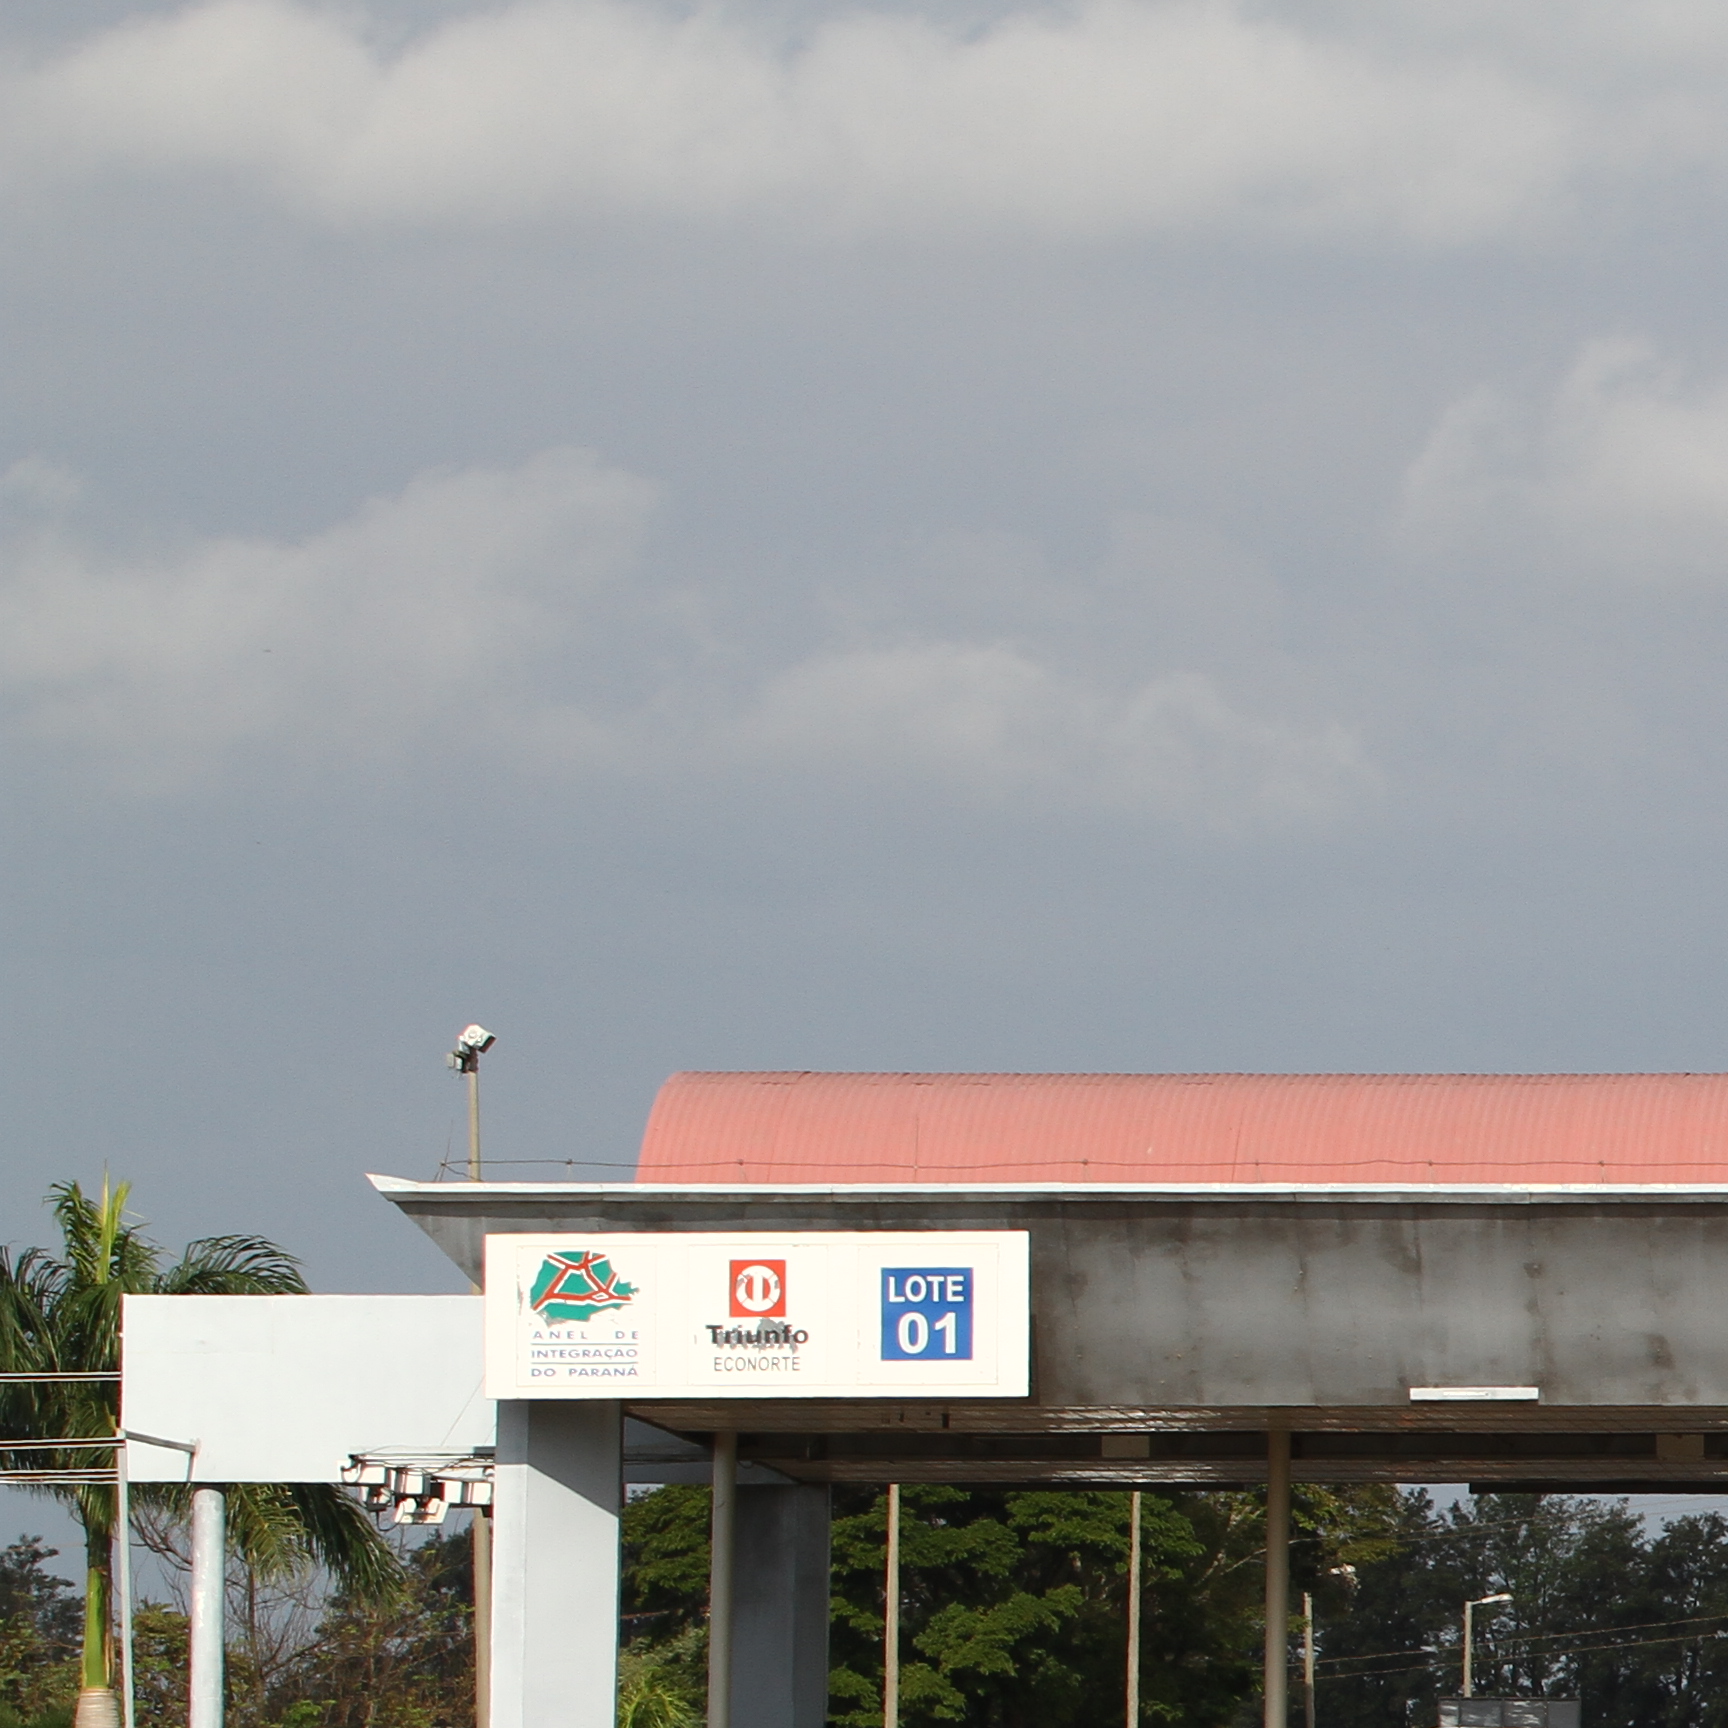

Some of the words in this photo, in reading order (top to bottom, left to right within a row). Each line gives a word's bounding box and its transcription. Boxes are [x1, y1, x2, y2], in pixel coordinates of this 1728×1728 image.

[887, 1274, 965, 1303] LOTE
[532, 1330, 588, 1340] ANEL
[614, 1330, 639, 1340] DE
[705, 1323, 809, 1345] Triunfo
[897, 1311, 957, 1355] 01
[531, 1346, 638, 1360] INTEGRAÇÃO
[531, 1368, 556, 1377] DO
[568, 1364, 639, 1377] PARANÁ
[713, 1356, 801, 1372] ECONORTE
